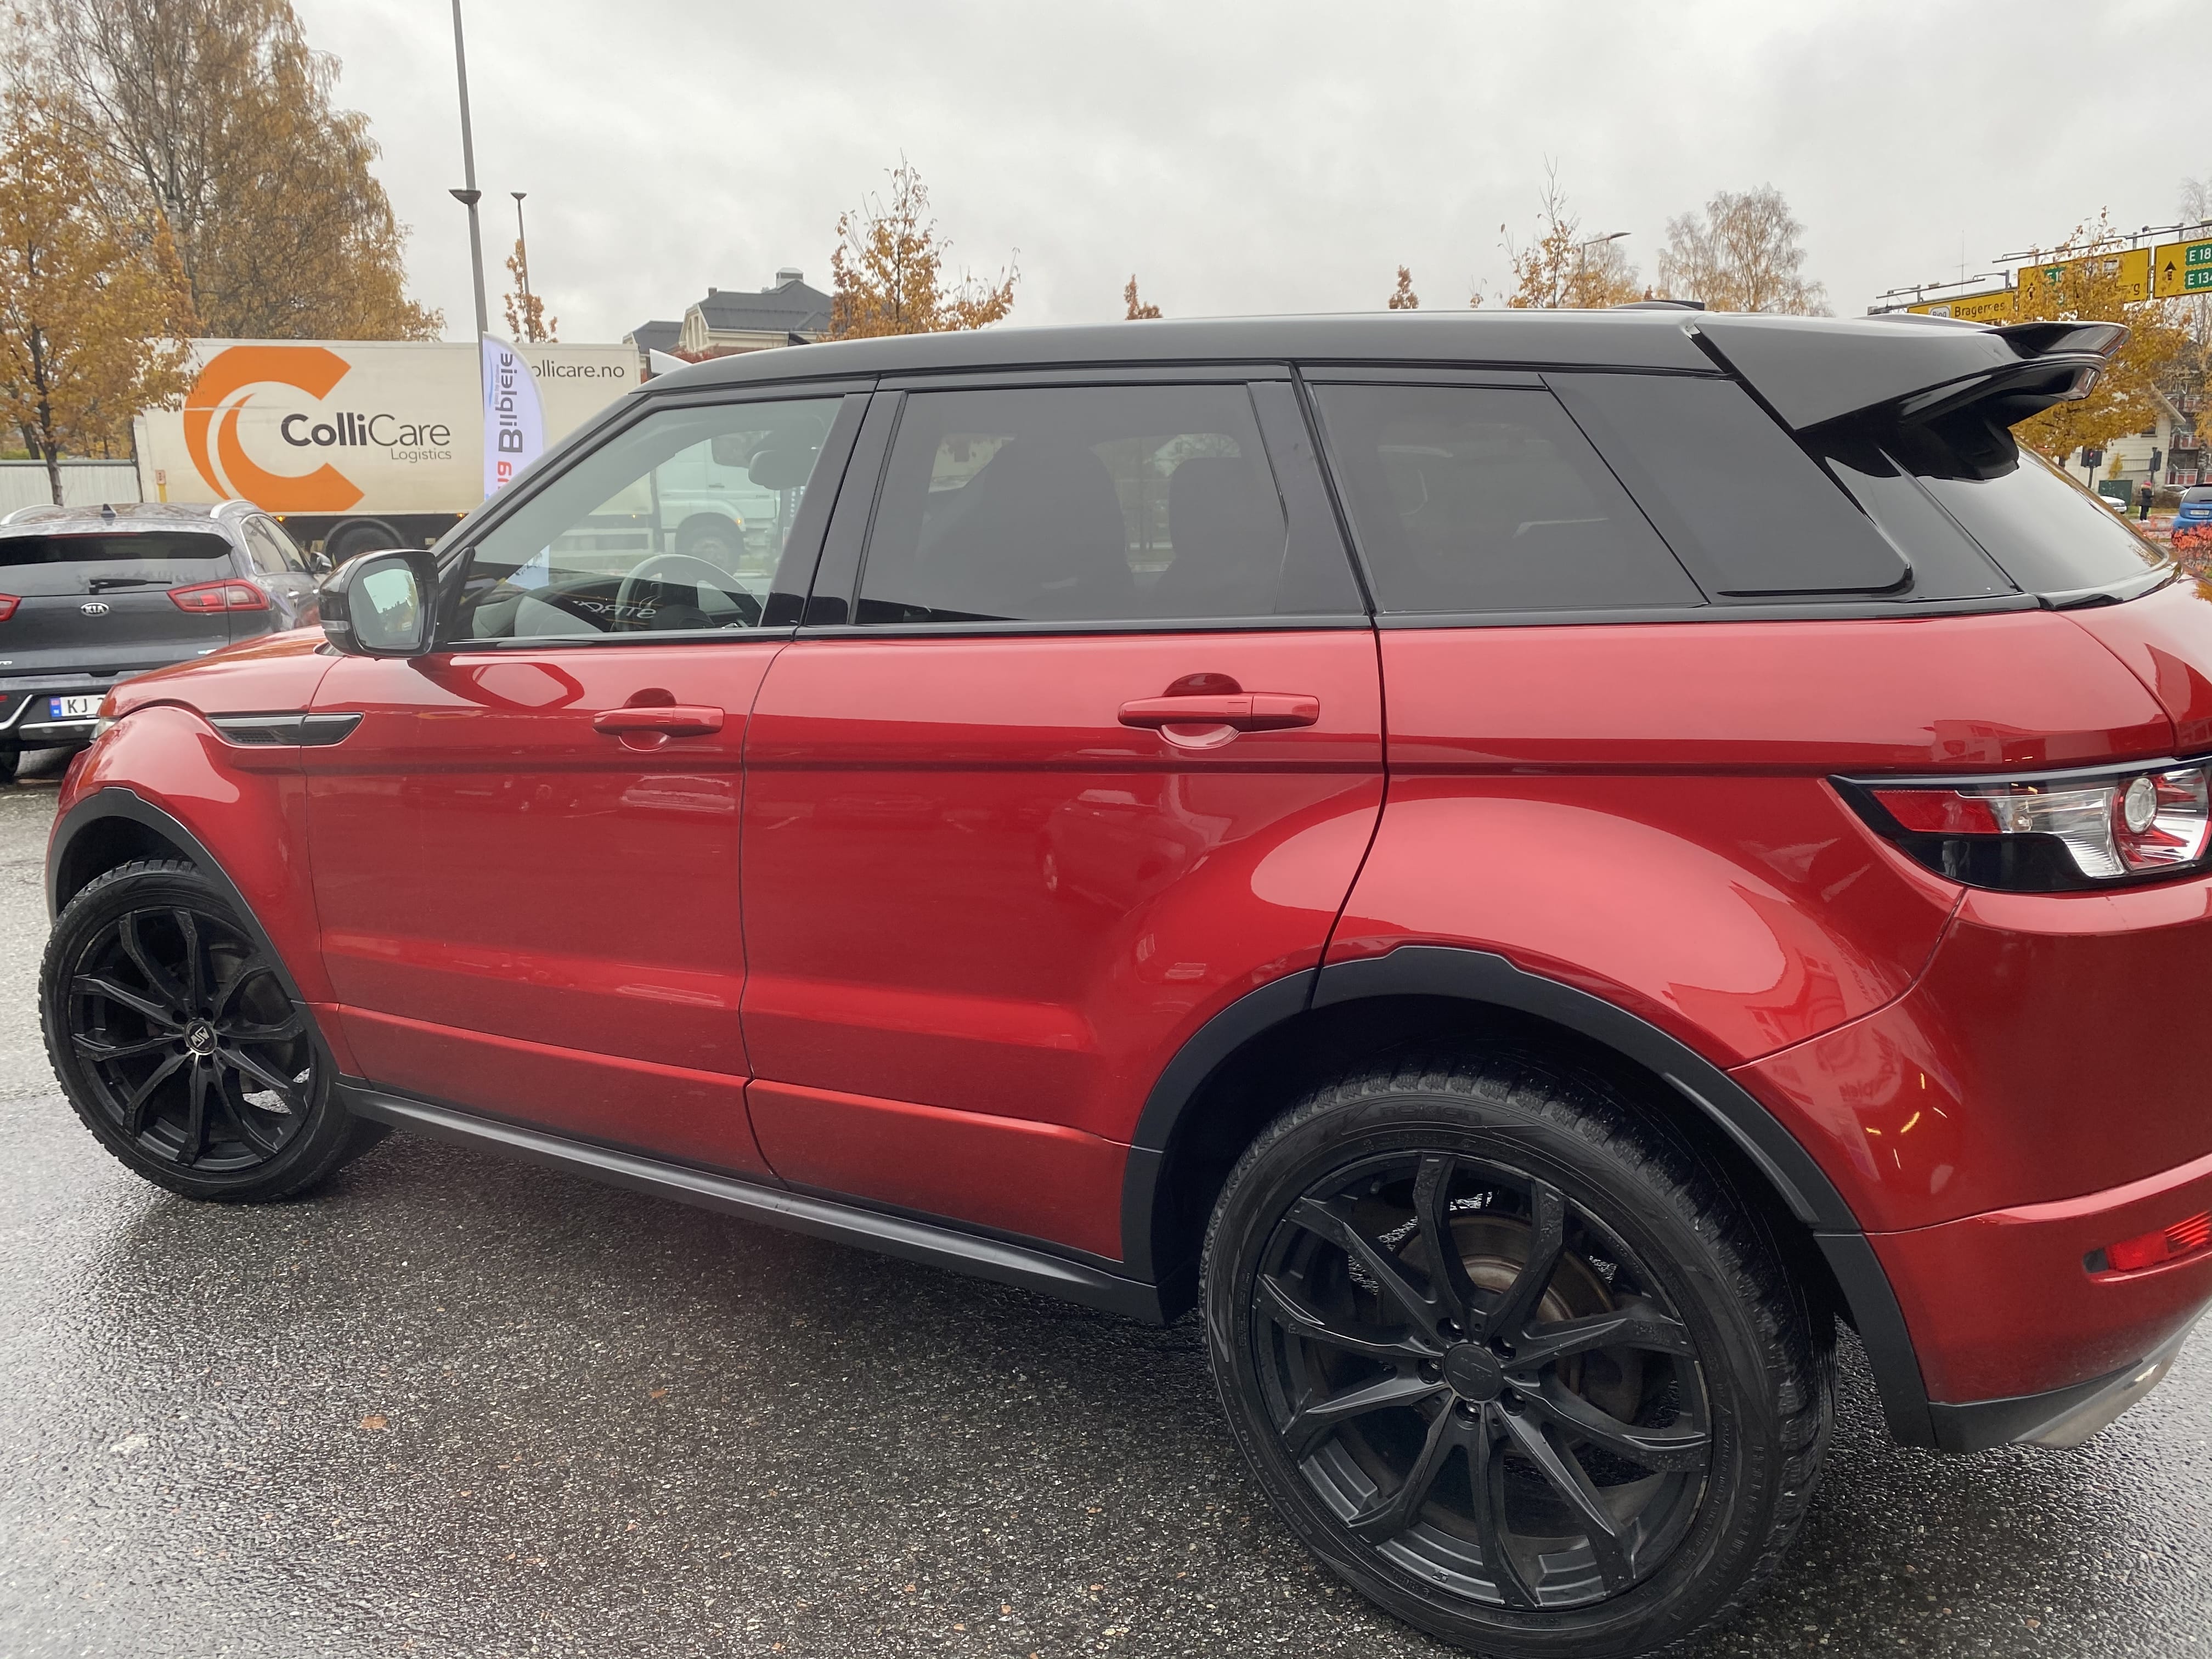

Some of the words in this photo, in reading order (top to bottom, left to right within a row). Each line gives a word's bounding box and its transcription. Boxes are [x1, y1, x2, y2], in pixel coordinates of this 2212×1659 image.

[2189, 250, 2196, 262] E
[2200, 247, 2211, 260] 18
[2188, 274, 2195, 285] E
[531, 359, 625, 378] ollicare.no
[280, 412, 451, 447] ColliCare
[391, 448, 452, 463] Logistics
[85, 605, 105, 614] KIA
[67, 698, 87, 713] KJ
